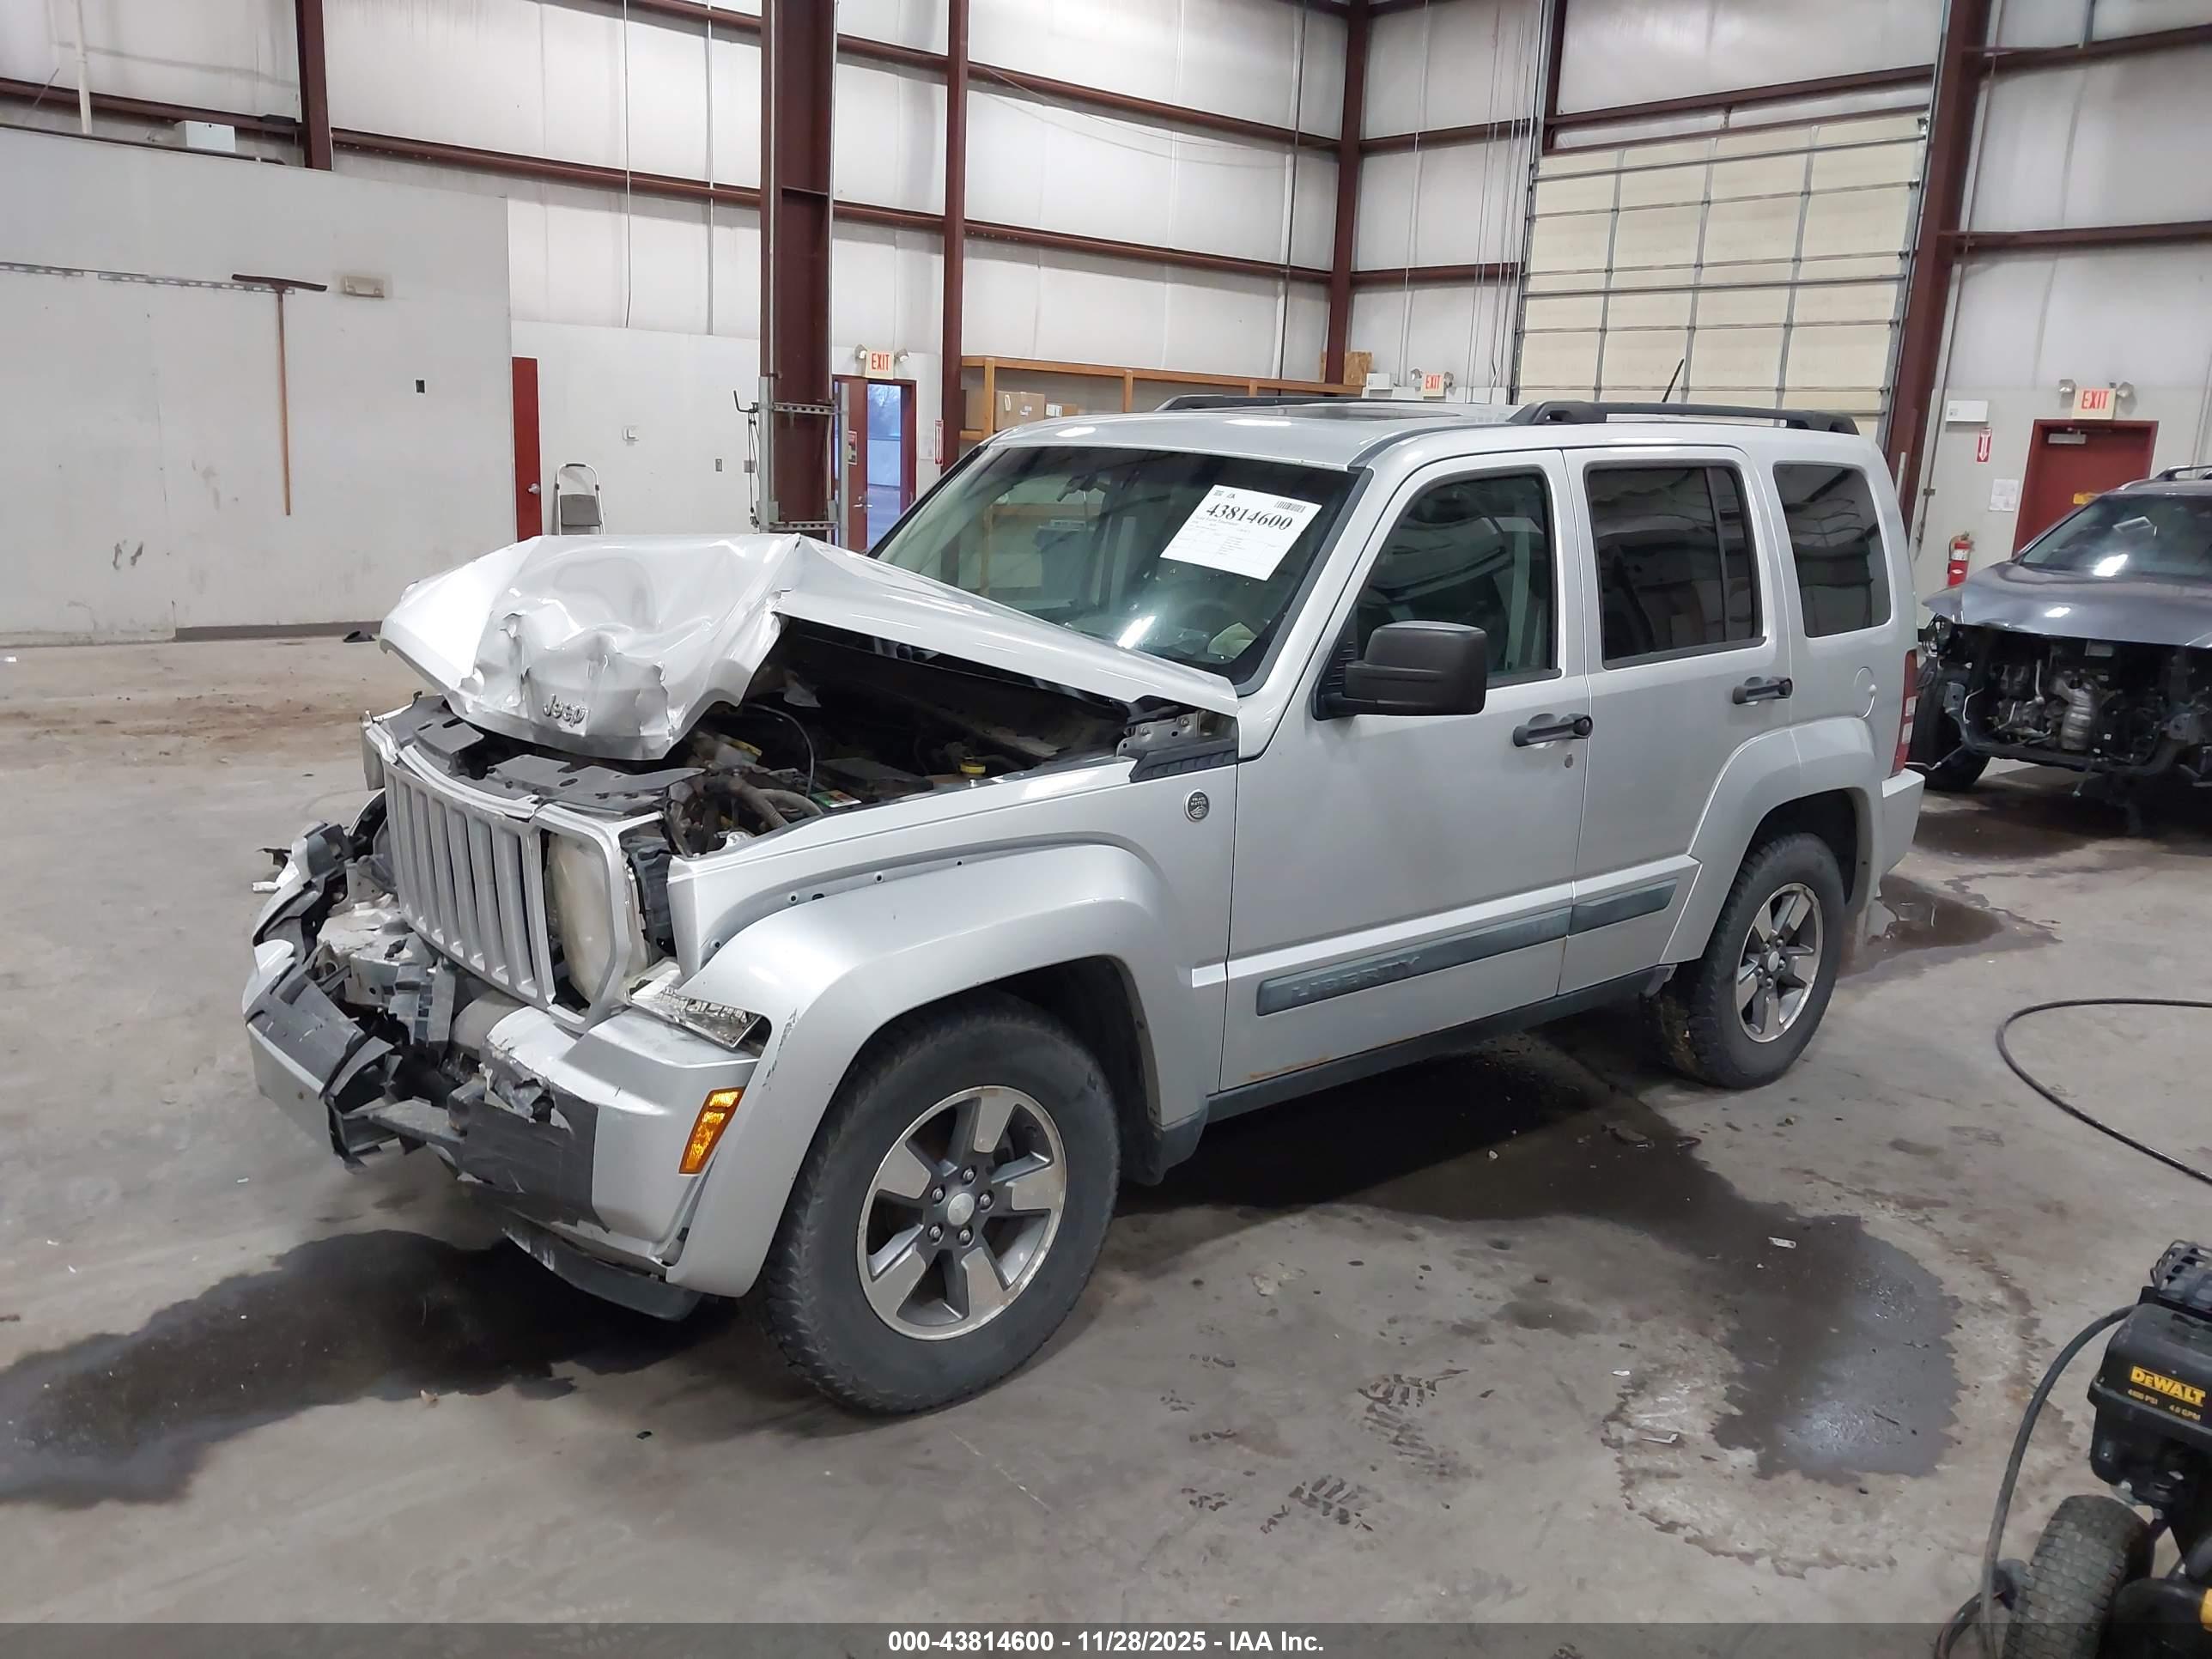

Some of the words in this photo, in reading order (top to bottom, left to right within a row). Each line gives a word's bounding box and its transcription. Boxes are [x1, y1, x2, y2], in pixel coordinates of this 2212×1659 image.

[872, 353, 890, 371] EXIT
[1425, 374, 1441, 389] EXIT
[2081, 391, 2109, 409] EXIT
[1206, 502, 1293, 531] 43814600
[543, 694, 586, 726] Jeep
[1291, 955, 1421, 1000] LIBERTY
